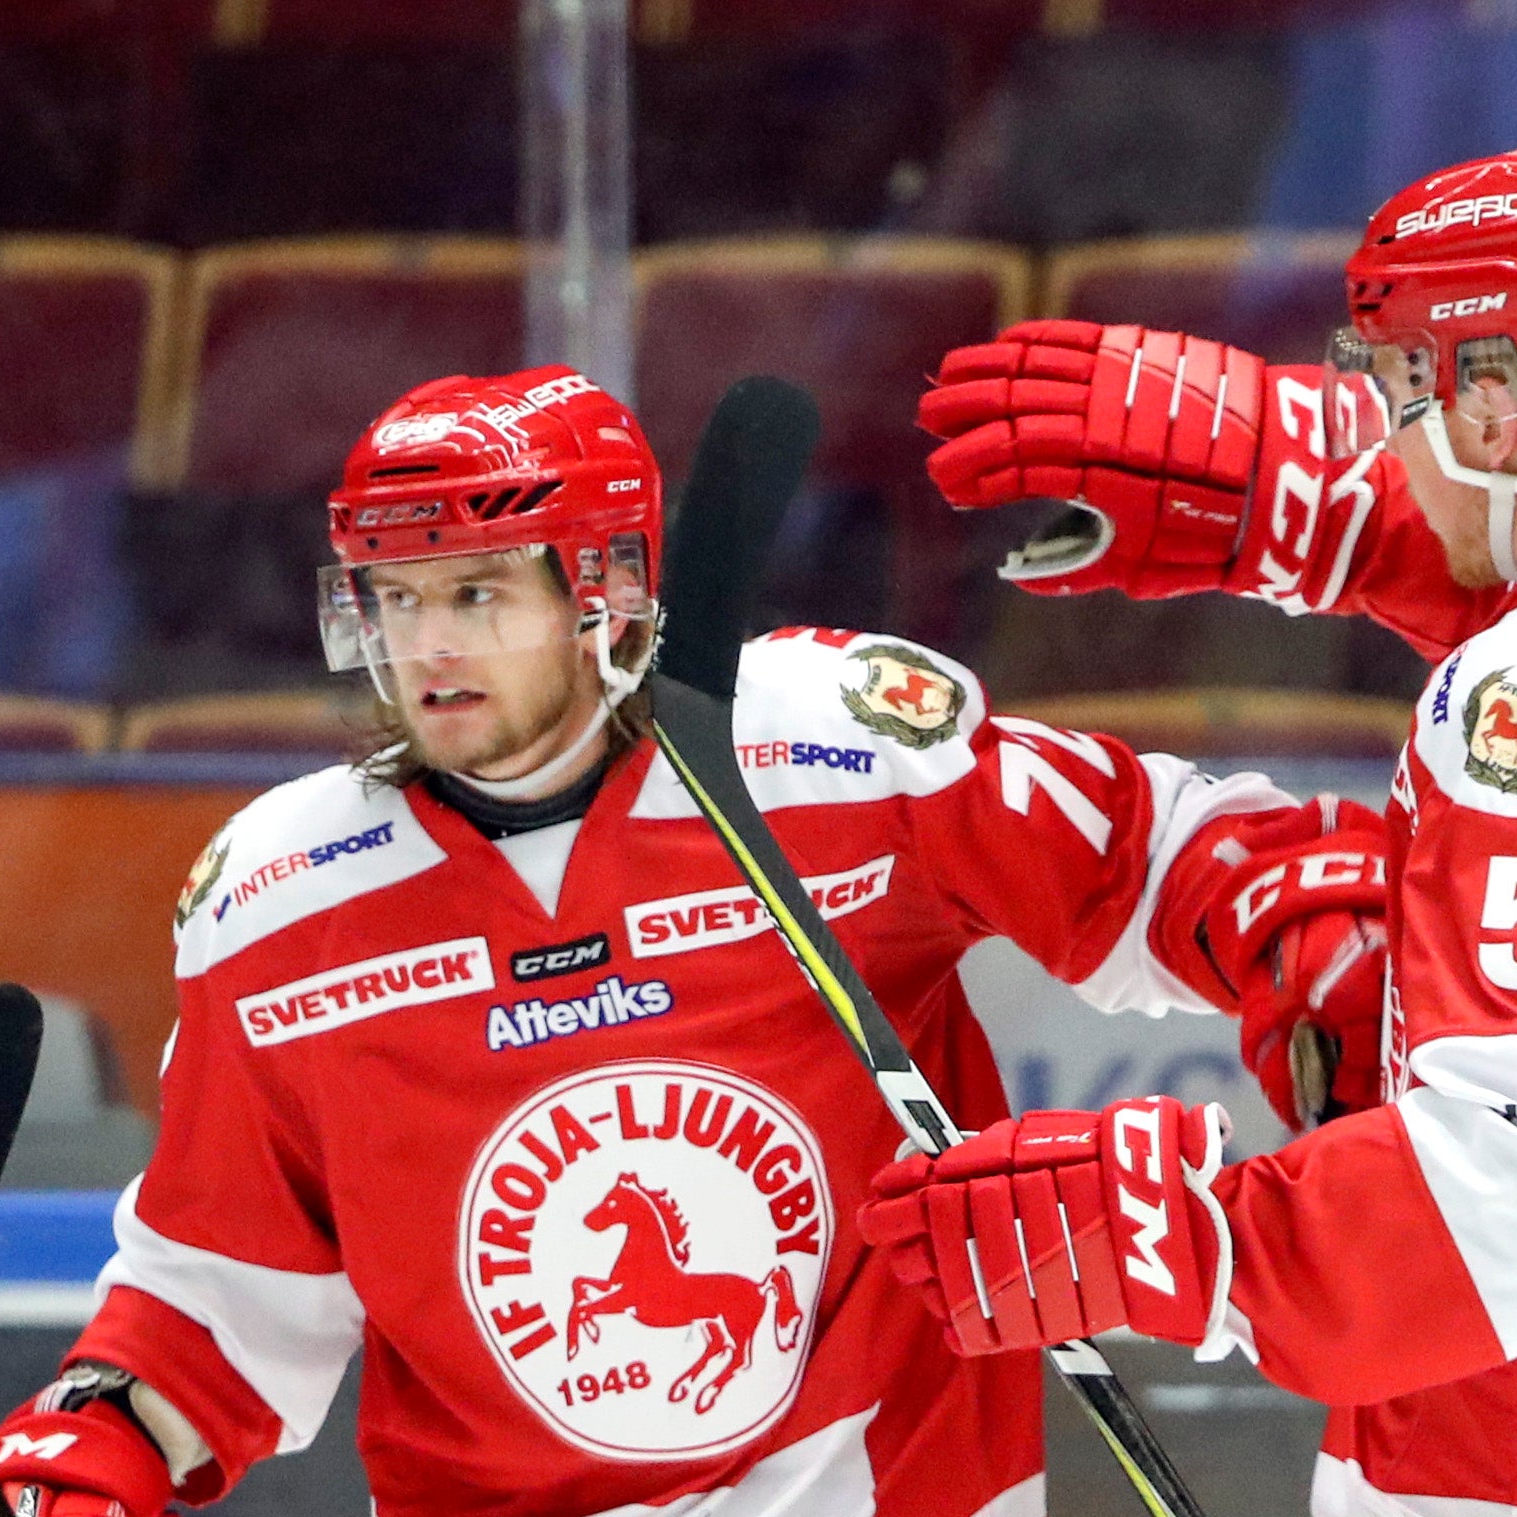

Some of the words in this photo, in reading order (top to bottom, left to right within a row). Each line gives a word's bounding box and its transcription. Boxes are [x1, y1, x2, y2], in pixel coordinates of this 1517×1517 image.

[1429, 292, 1508, 321] CCM
[355, 500, 447, 528] CCM
[606, 477, 642, 494] CCM
[233, 820, 395, 907] INTERSPORT
[1232, 852, 1388, 935] CC
[515, 940, 605, 974] CCM
[246, 951, 477, 1036] SVETRUCK
[487, 976, 673, 1050] Atteviks
[478, 1083, 821, 1287] TROJA-LJUNGBY
[1112, 1095, 1177, 1297] CM
[490, 1299, 558, 1361] IF
[556, 1360, 652, 1407] 1948
